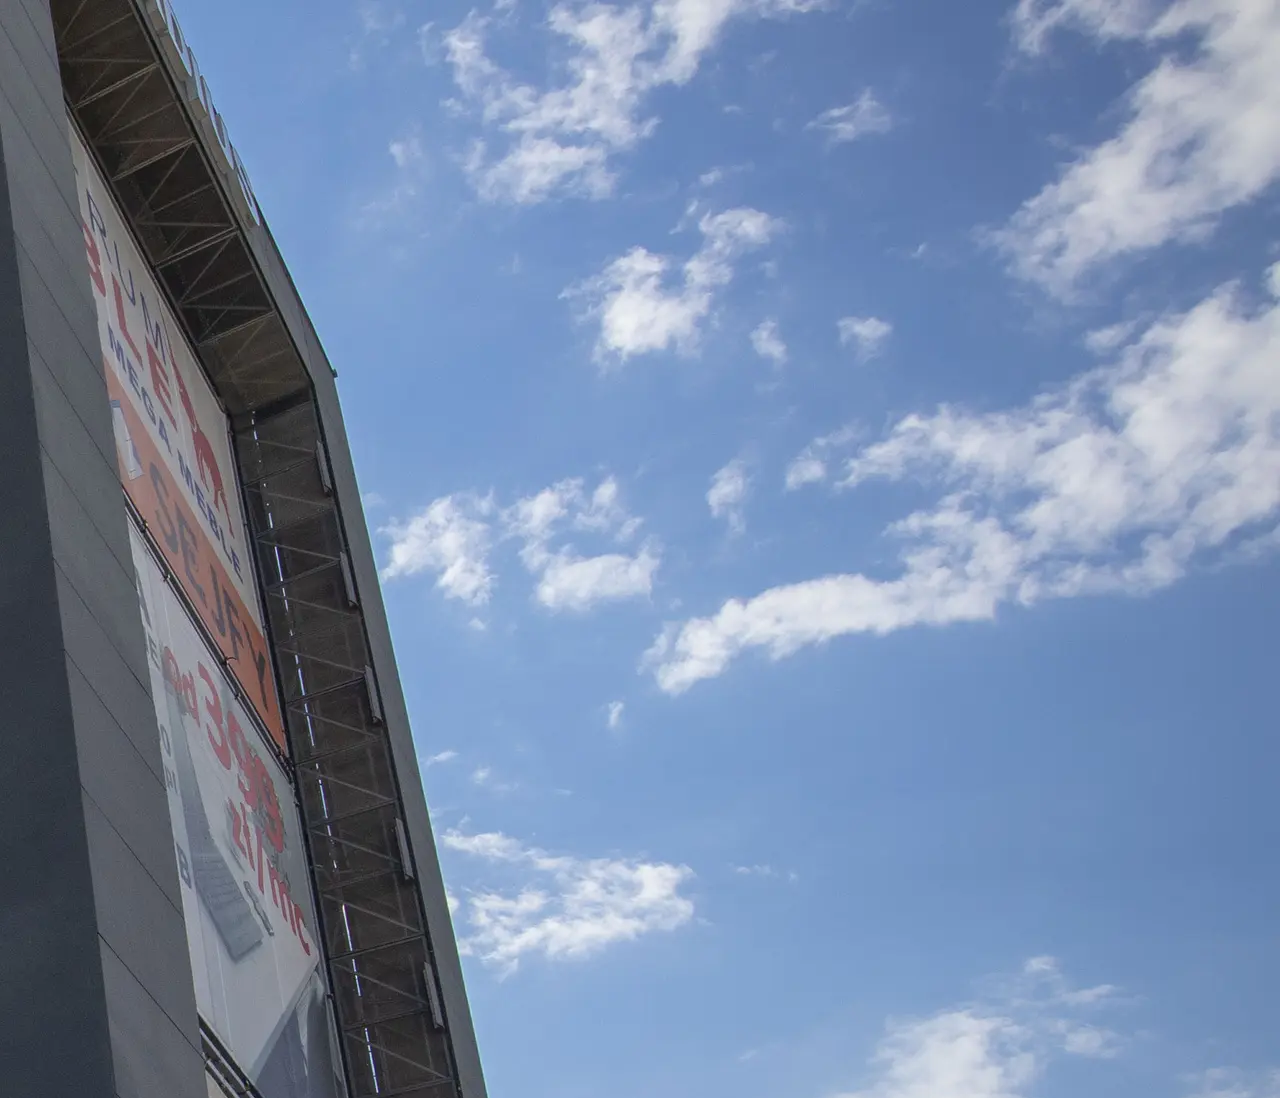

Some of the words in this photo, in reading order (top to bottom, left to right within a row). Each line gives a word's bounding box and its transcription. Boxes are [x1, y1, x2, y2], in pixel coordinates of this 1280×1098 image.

[72, 163, 166, 366] RUM
[107, 321, 172, 457] MEGA
[177, 448, 244, 585] MEBLE
[149, 461, 269, 713] SEJFY
[197, 660, 284, 854] 399
